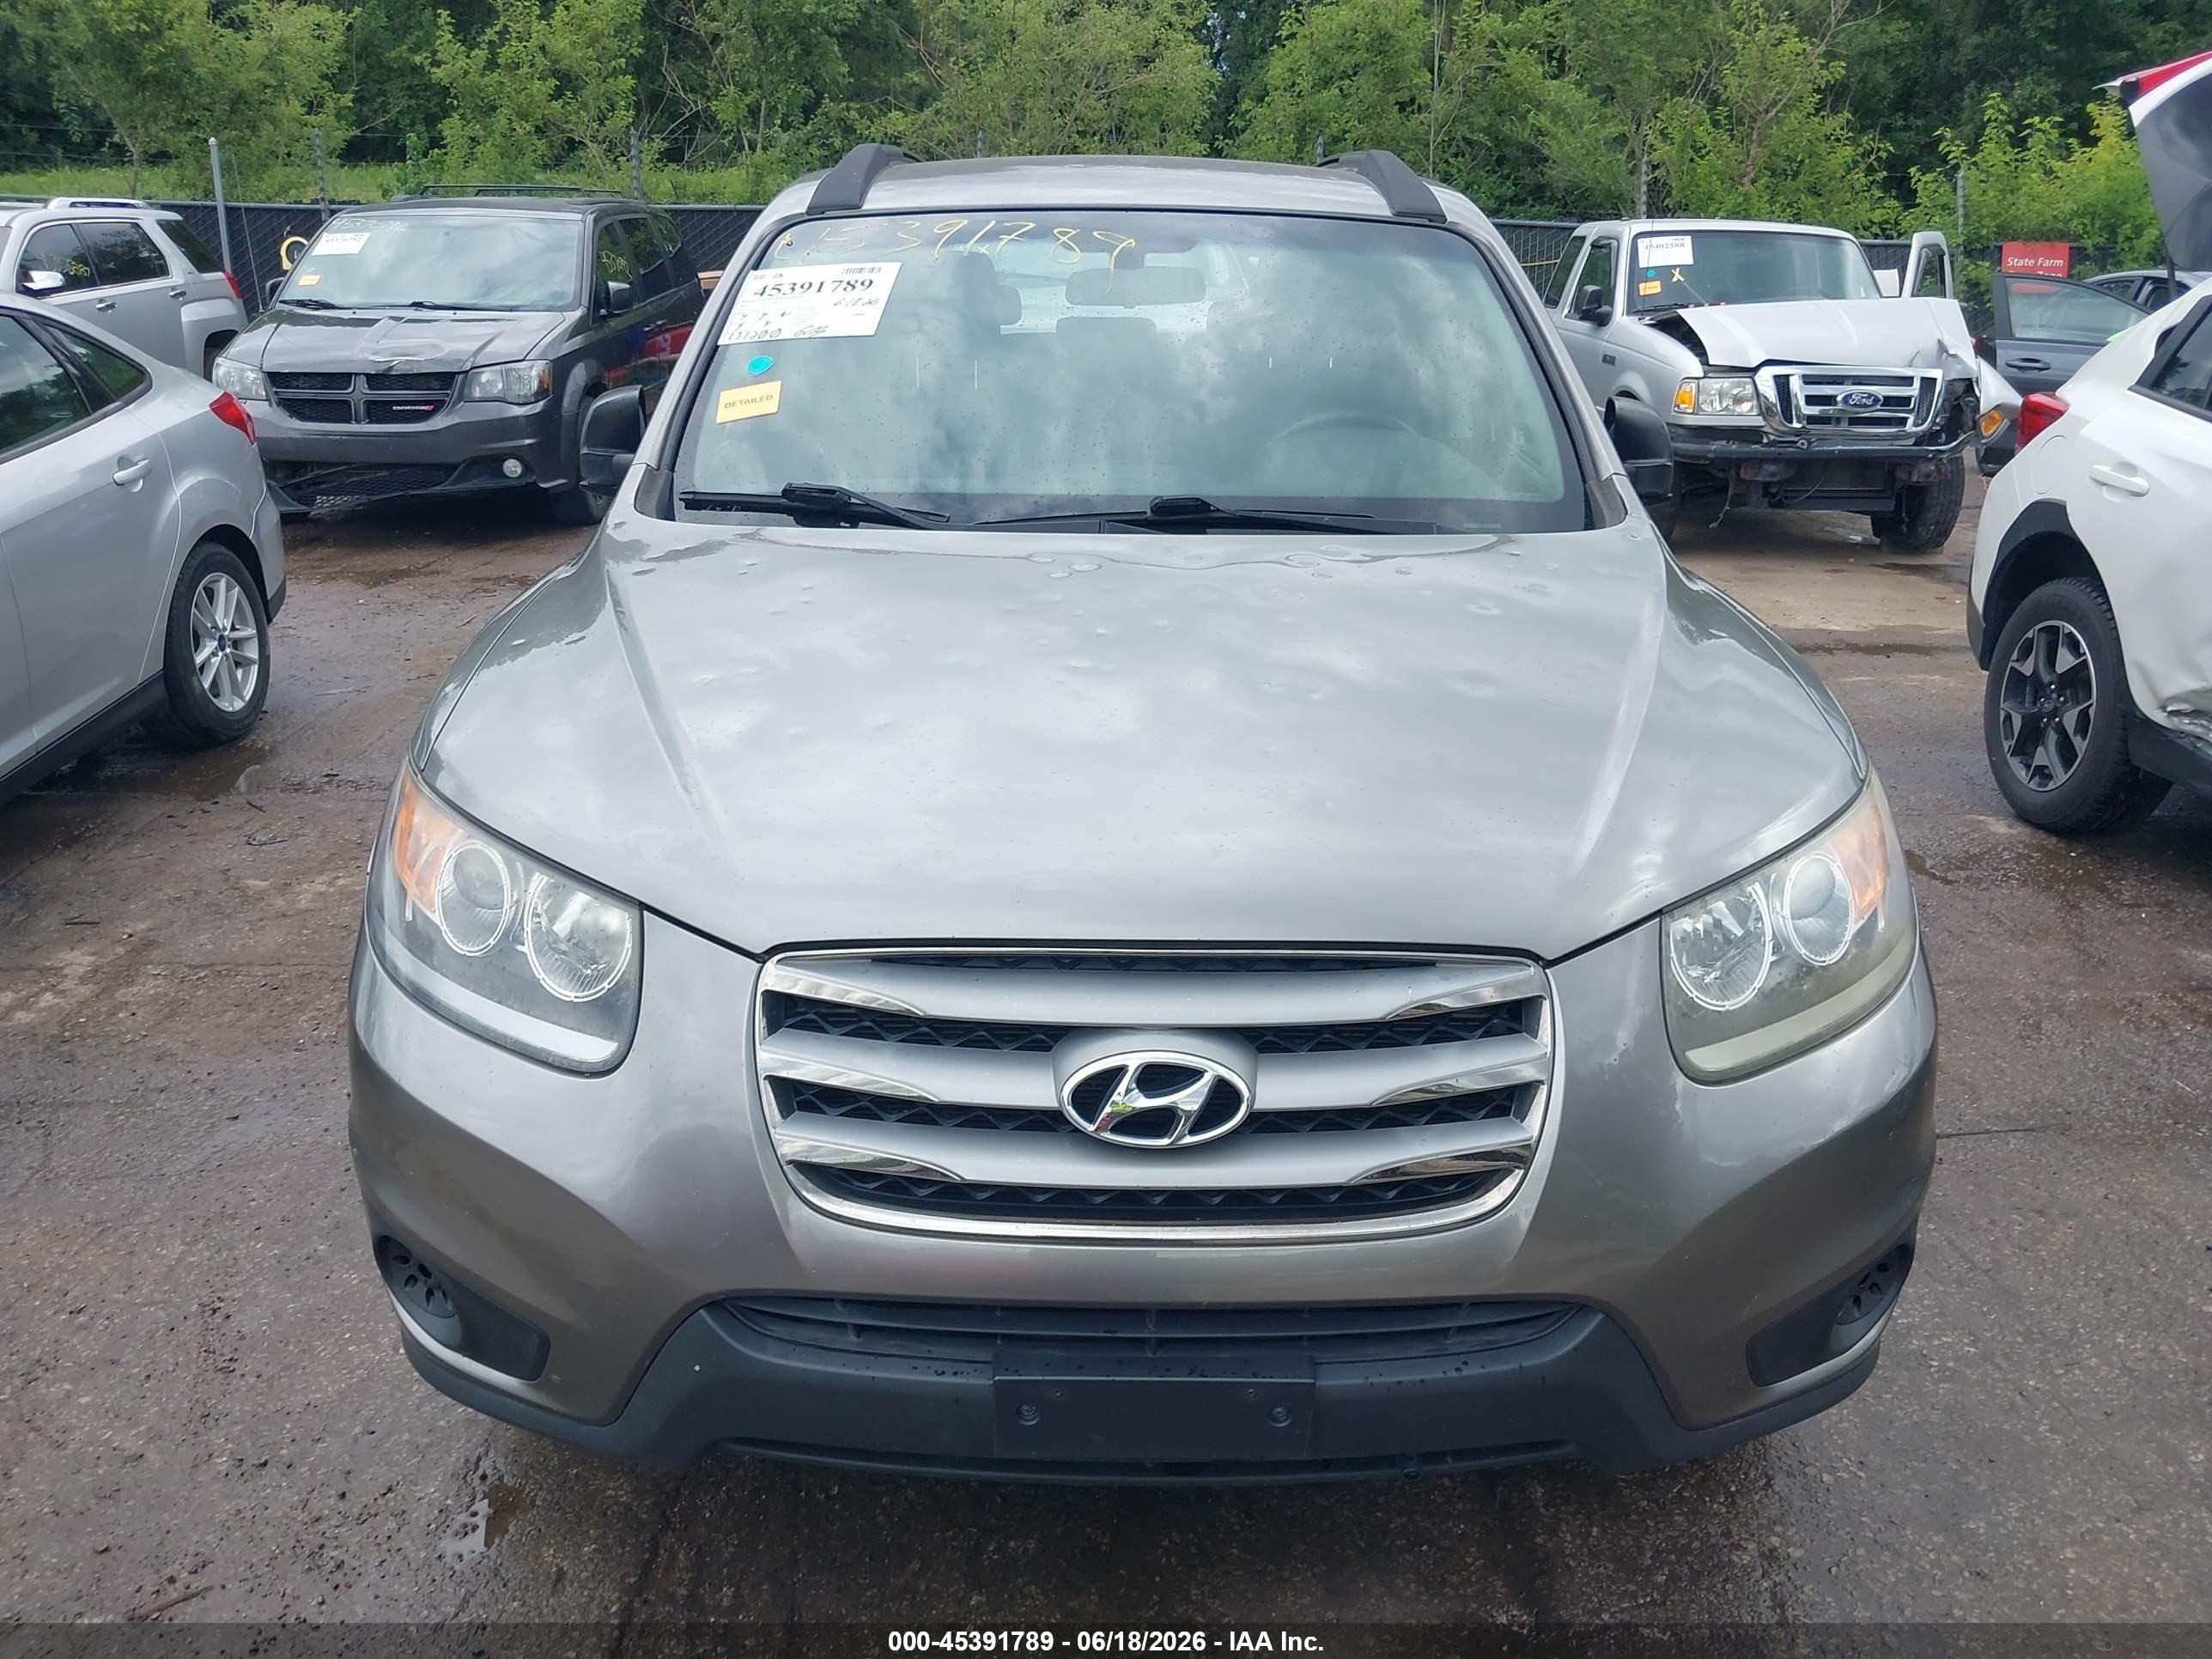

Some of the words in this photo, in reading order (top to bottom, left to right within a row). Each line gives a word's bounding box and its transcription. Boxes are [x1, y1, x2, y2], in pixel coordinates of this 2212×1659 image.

[2006, 256, 2035, 267] State
[2036, 257, 2064, 268] Farm
[753, 278, 874, 298] 45391789
[724, 393, 775, 410] DETAILED
[1848, 392, 1875, 405] Ford
